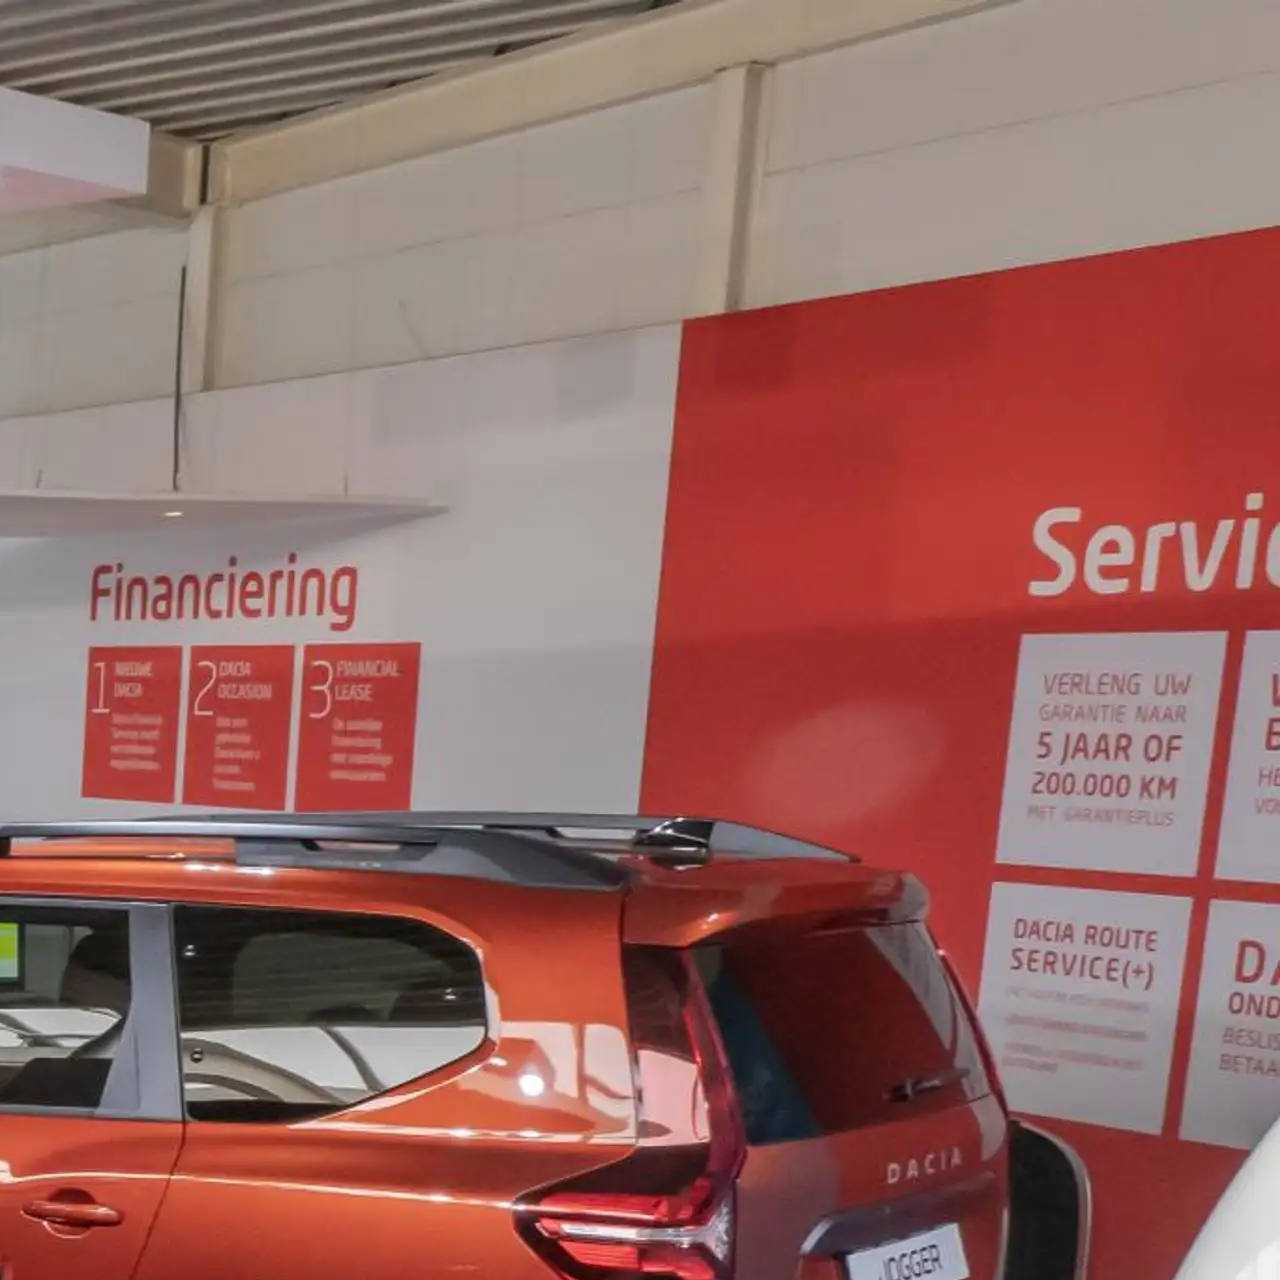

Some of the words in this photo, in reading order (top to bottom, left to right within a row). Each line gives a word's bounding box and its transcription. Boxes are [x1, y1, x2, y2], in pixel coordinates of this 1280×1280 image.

[90, 552, 358, 632] Financiering
[336, 660, 400, 676] FINANCIAL
[1043, 673, 1142, 695] VERLENG
[1154, 673, 1193, 696] UW
[90, 662, 111, 714] 1
[194, 660, 217, 716] 2
[308, 660, 333, 718] 3
[334, 684, 372, 701] LEASE
[1039, 704, 1128, 723] GARANTIE
[1135, 704, 1188, 724] NAAR
[1036, 731, 1053, 760] 5
[1059, 732, 1133, 766] JAAR
[1143, 733, 1183, 763] OF
[1030, 771, 1131, 798] 200.000
[1139, 775, 1179, 801] KM
[1013, 918, 1075, 943] DACIA
[1084, 925, 1158, 952] ROUTE
[1010, 947, 1155, 991] SERVICE(+)
[886, 1146, 963, 1184] DACIA
